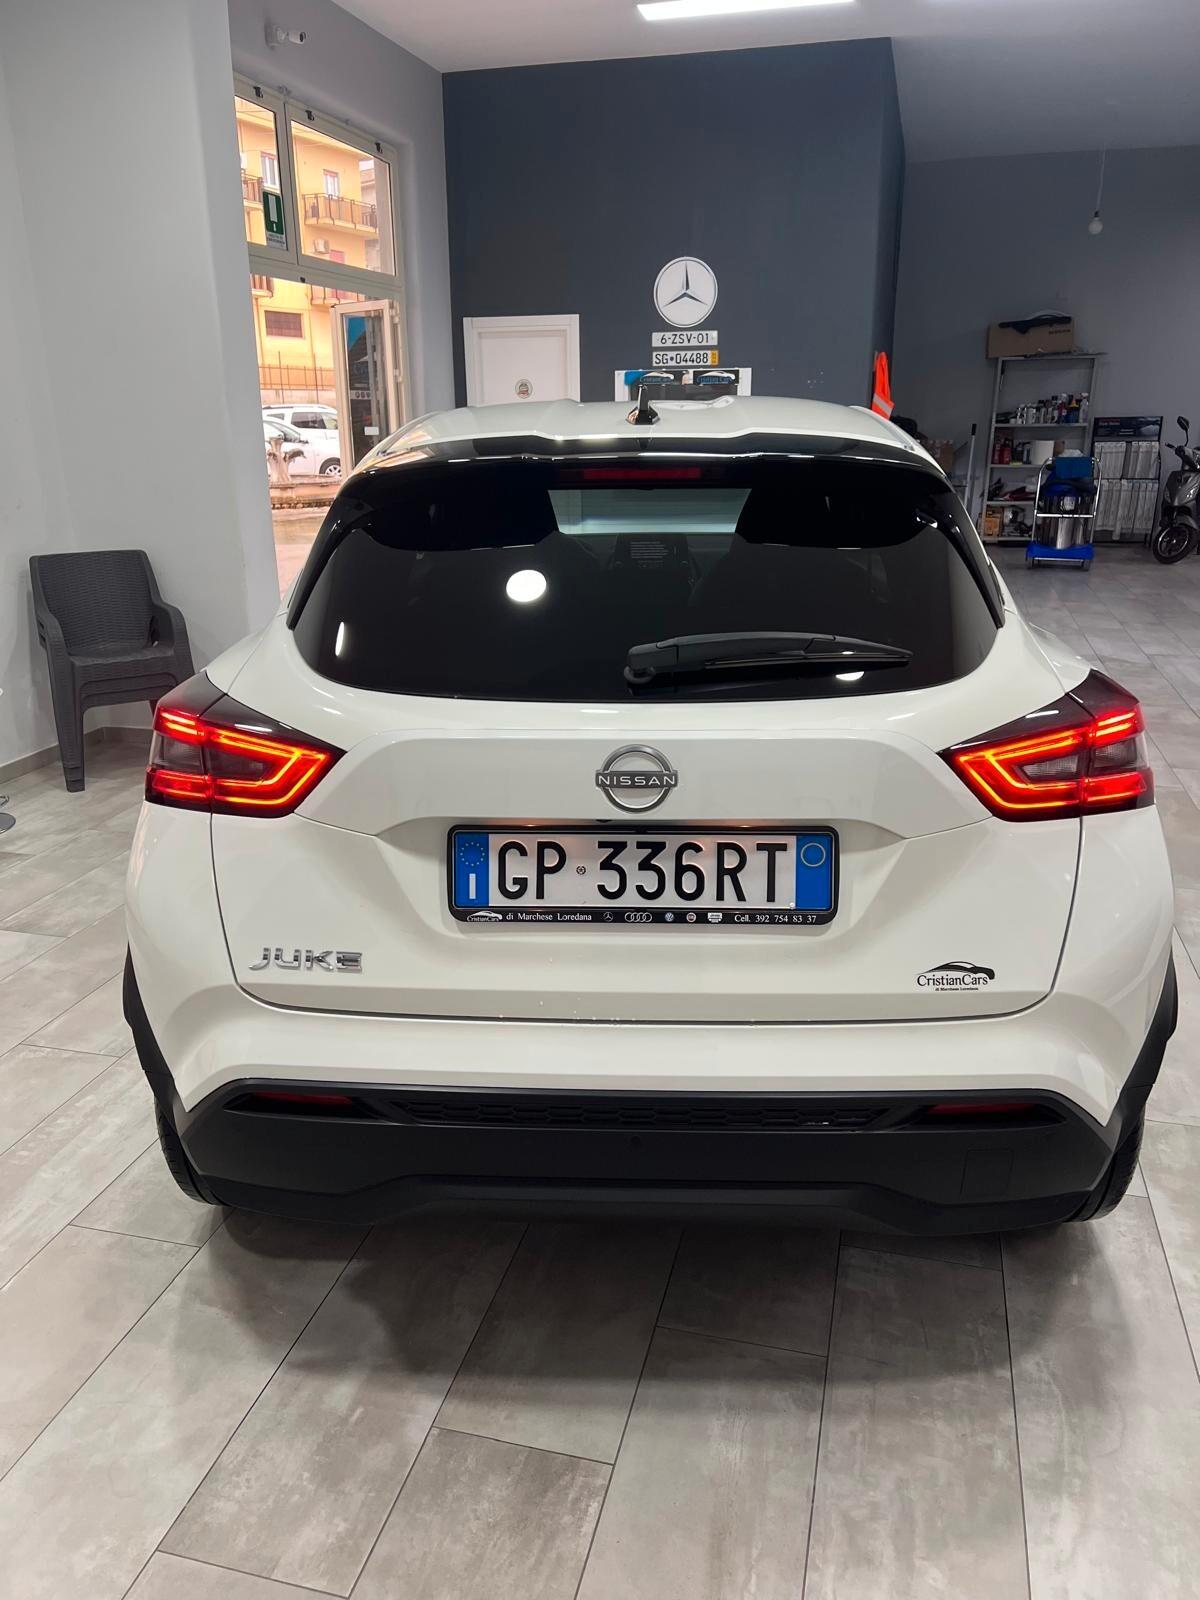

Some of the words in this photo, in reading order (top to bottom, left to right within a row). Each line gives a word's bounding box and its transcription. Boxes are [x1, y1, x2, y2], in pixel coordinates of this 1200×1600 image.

[660, 333, 709, 344] 6-ZSV-01
[654, 353, 669, 365] SG
[675, 352, 709, 365] 04488
[598, 775, 676, 786] NISSAN
[497, 840, 567, 900] GP
[596, 840, 788, 903] 336RT
[506, 912, 514, 920] di
[517, 912, 553, 921] Marchese
[557, 912, 592, 921] Loredana
[734, 915, 751, 923] Cell.
[755, 915, 770, 923] 392
[774, 915, 788, 923] 754
[792, 915, 803, 923] 83
[807, 915, 817, 923] 37
[247, 947, 363, 974] JUKE
[917, 974, 988, 986] CristianCars
